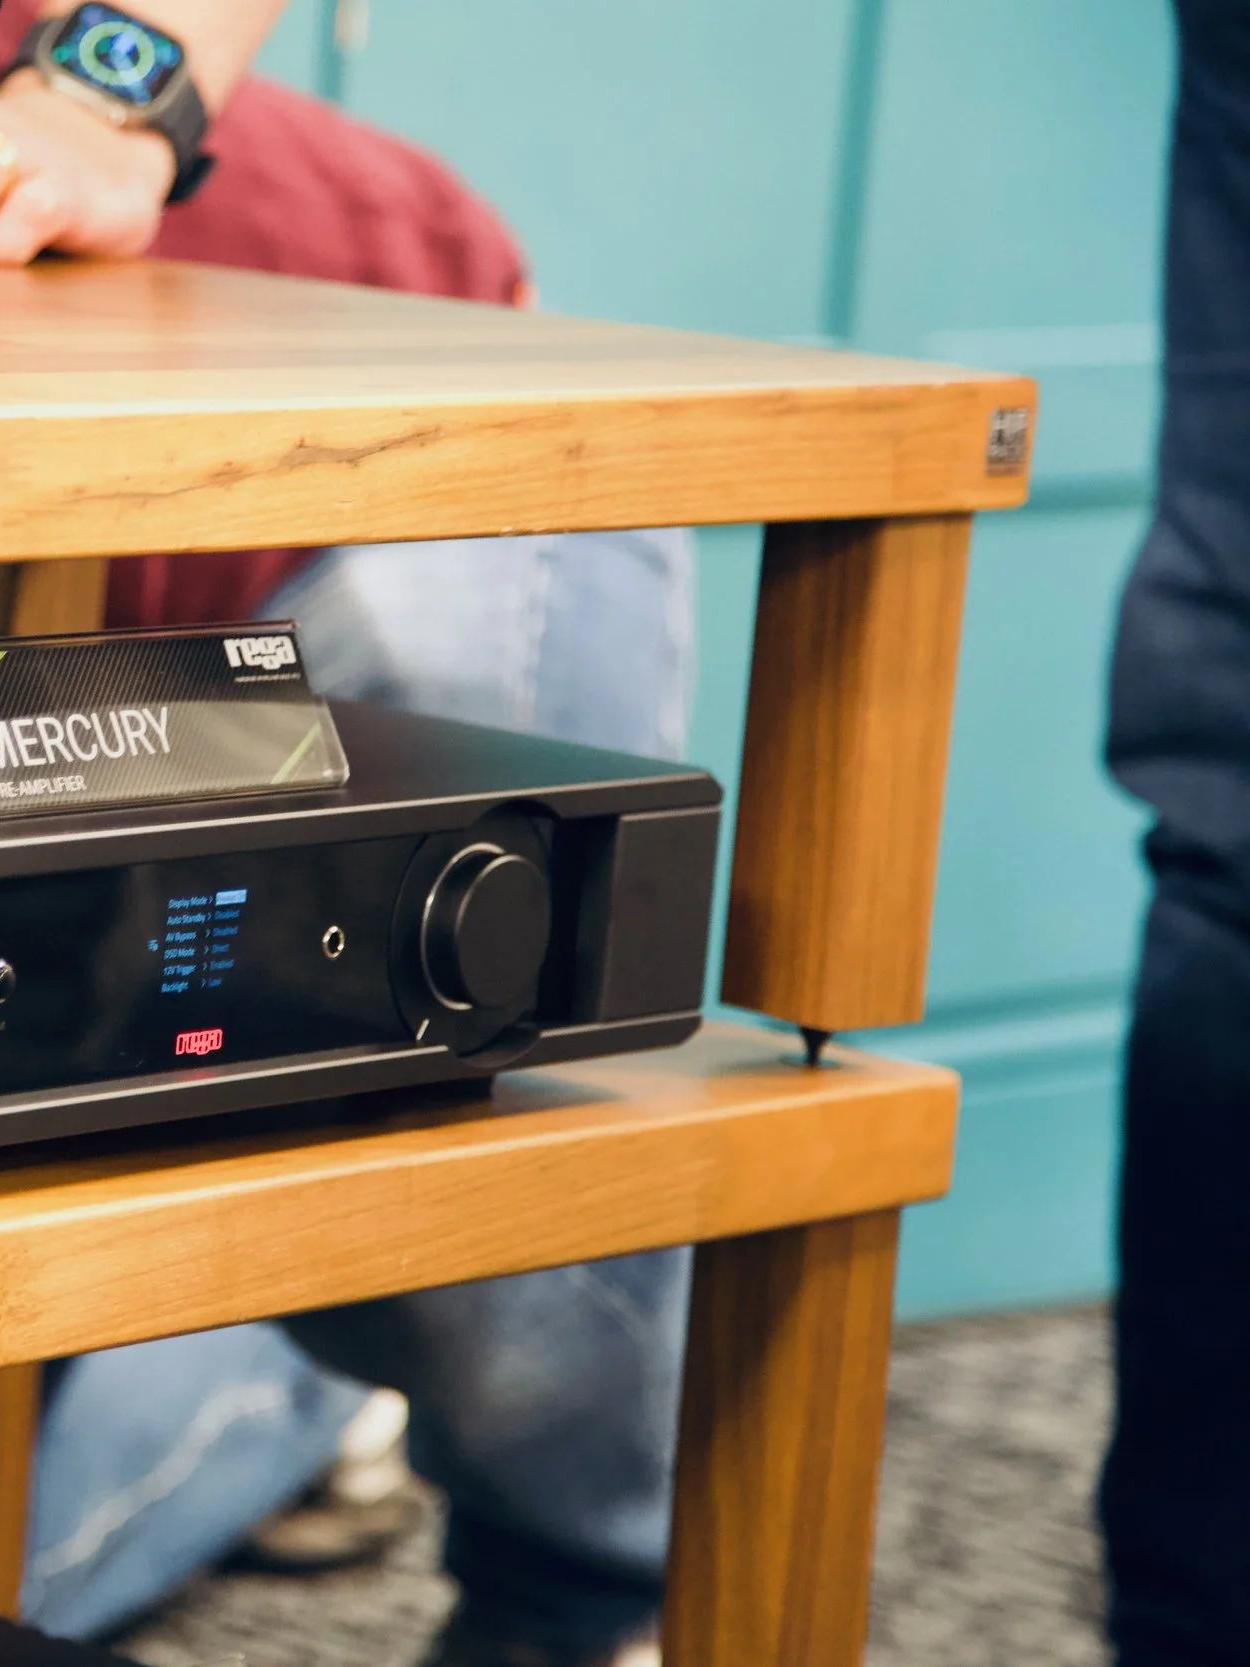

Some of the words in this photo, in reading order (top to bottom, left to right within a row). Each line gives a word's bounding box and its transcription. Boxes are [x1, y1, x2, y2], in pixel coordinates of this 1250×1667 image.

[223, 635, 297, 670] rega
[169, 899, 190, 909] Display
[190, 896, 208, 906] Mode
[167, 916, 183, 925] Auto
[183, 913, 206, 923] Standby
[166, 933, 174, 942] AV
[175, 932, 196, 942] Bypass
[178, 948, 195, 957] Mode
[176, 965, 196, 976] Trigger
[161, 982, 188, 993] Backlight
[175, 1028, 223, 1056] rega
